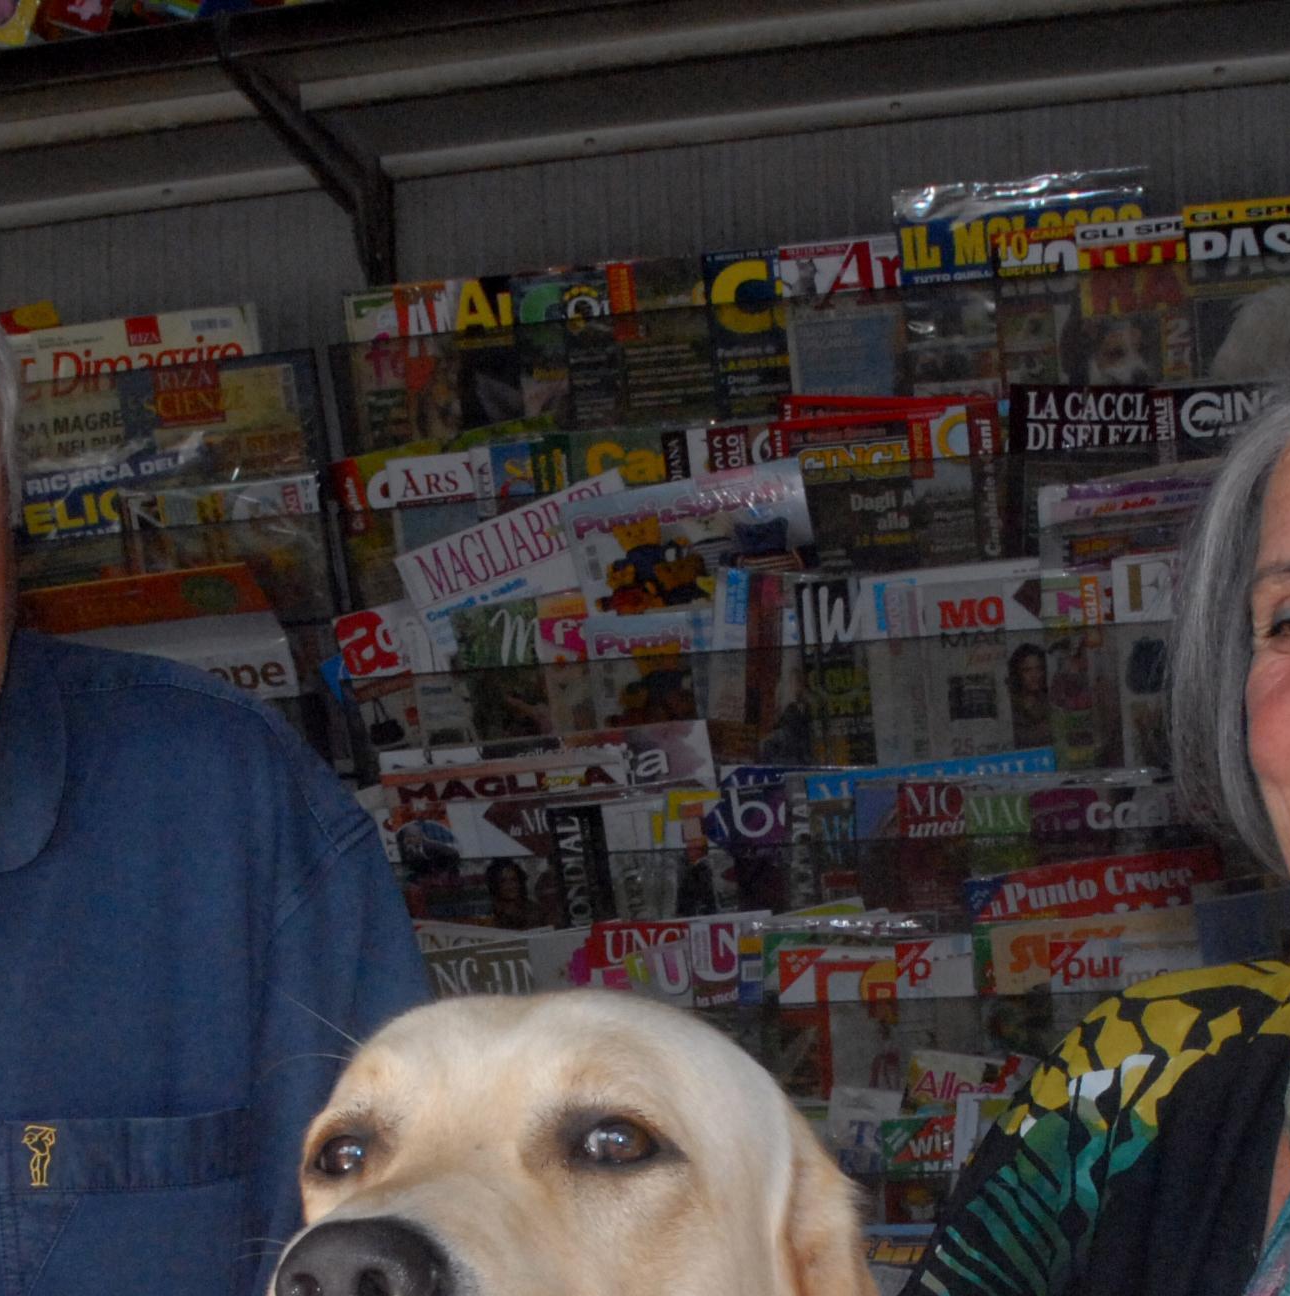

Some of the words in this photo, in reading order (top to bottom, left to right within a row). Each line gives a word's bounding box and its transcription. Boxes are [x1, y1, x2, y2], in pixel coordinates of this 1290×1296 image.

[1189, 208, 1234, 224] GLI
[900, 224, 942, 271] IL
[996, 229, 1030, 261] 10
[1079, 226, 1125, 241] GLI
[53, 335, 244, 398] Dimagrire
[1027, 392, 1063, 420] LA
[1026, 423, 1055, 450] DI
[25, 459, 136, 496] RICERCA
[1003, 877, 1099, 914] Punto
[1103, 865, 1194, 898] Croce
